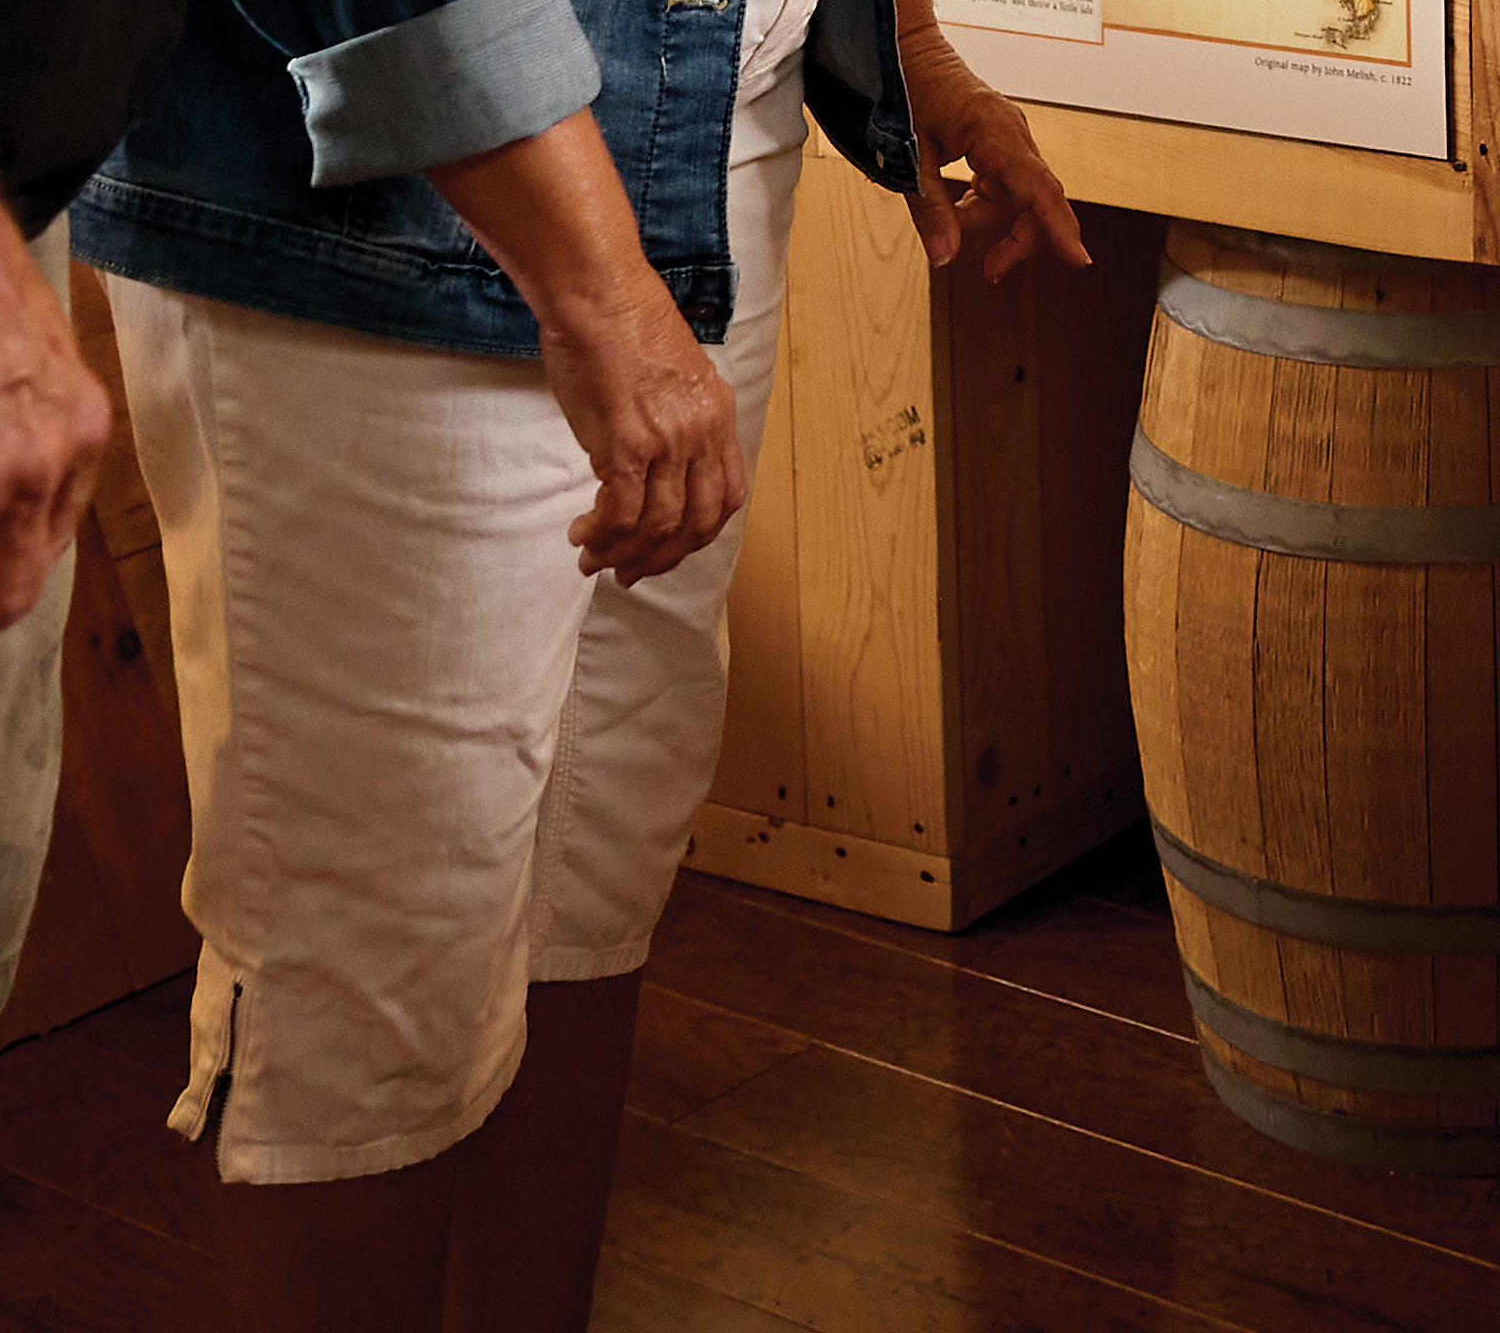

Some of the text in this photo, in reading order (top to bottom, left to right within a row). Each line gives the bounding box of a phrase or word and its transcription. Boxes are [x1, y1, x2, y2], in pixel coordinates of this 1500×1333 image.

[1255, 56, 1289, 70] Original
[1291, 62, 1310, 76] map
[1312, 63, 1322, 77] by
[1325, 65, 1344, 78] John
[1347, 69, 1377, 82] Melish,
[1391, 75, 1413, 86] 1822
